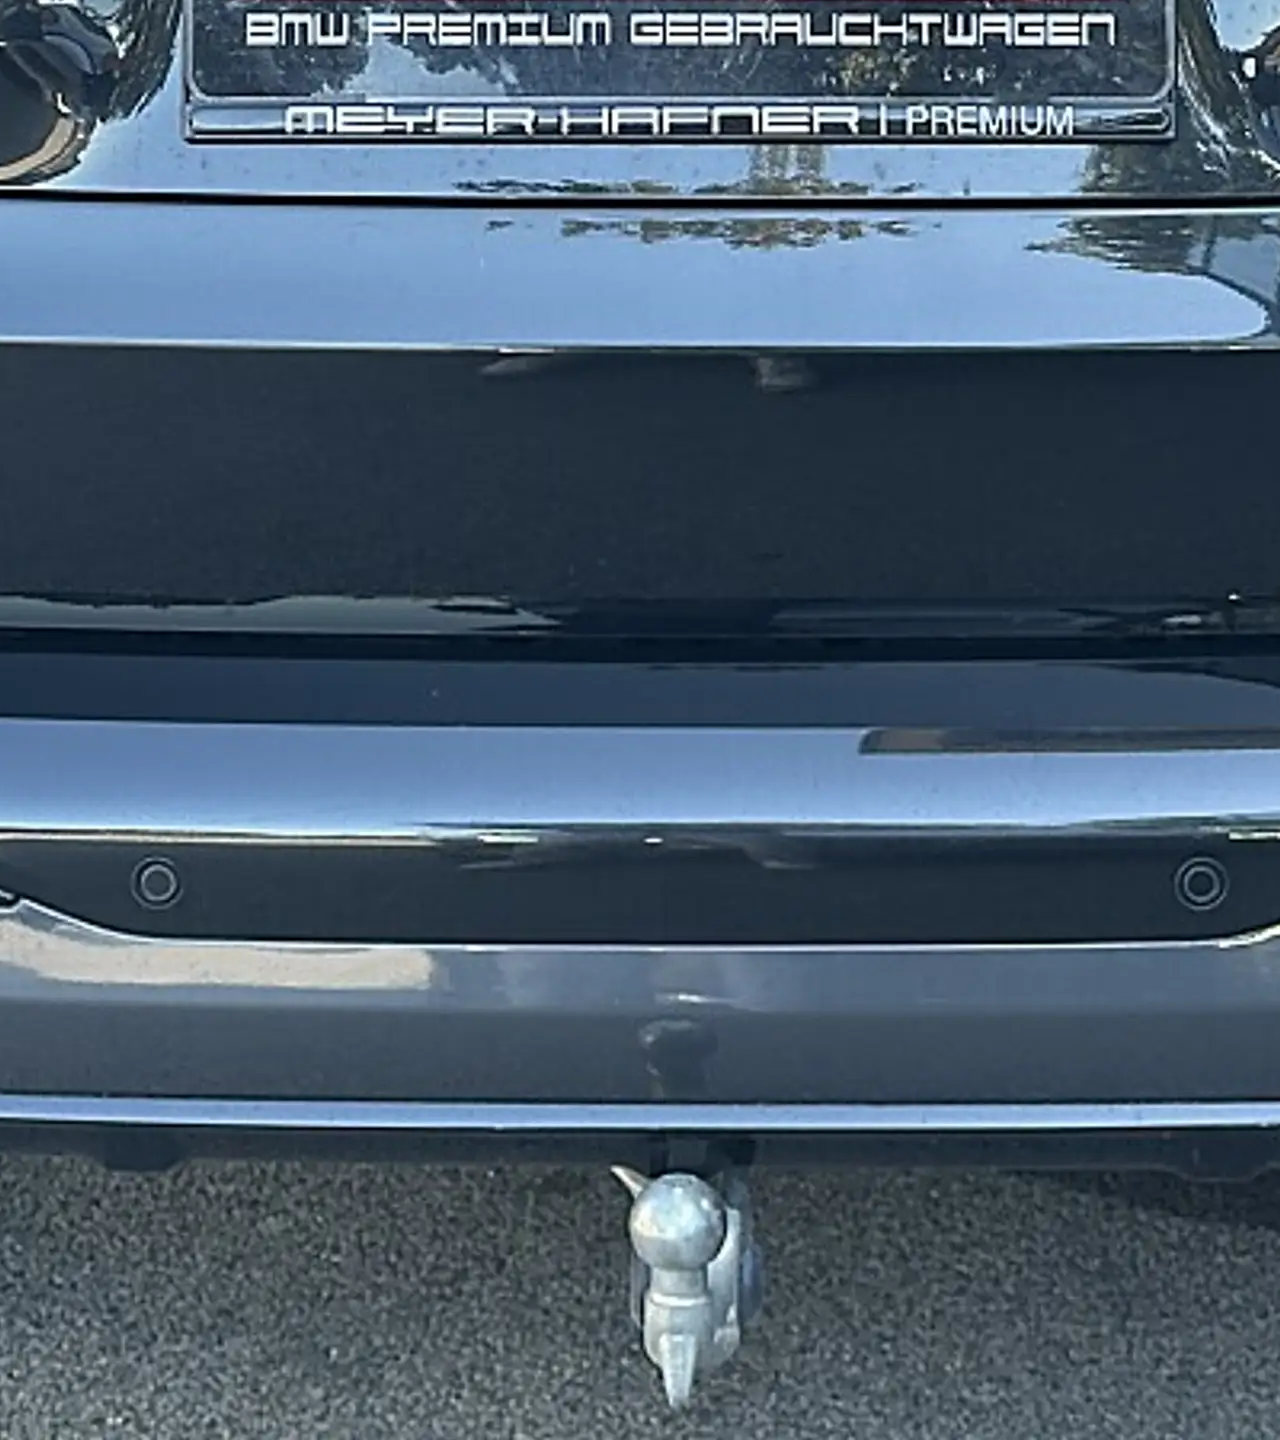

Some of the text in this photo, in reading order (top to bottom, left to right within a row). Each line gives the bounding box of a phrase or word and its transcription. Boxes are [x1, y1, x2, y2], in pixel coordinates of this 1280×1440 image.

[246, 13, 1115, 47] BMW PREMIUM GEBRAUCHTWAGEN
[284, 105, 1074, 136] MEYER-HAFNER PREMIUM
